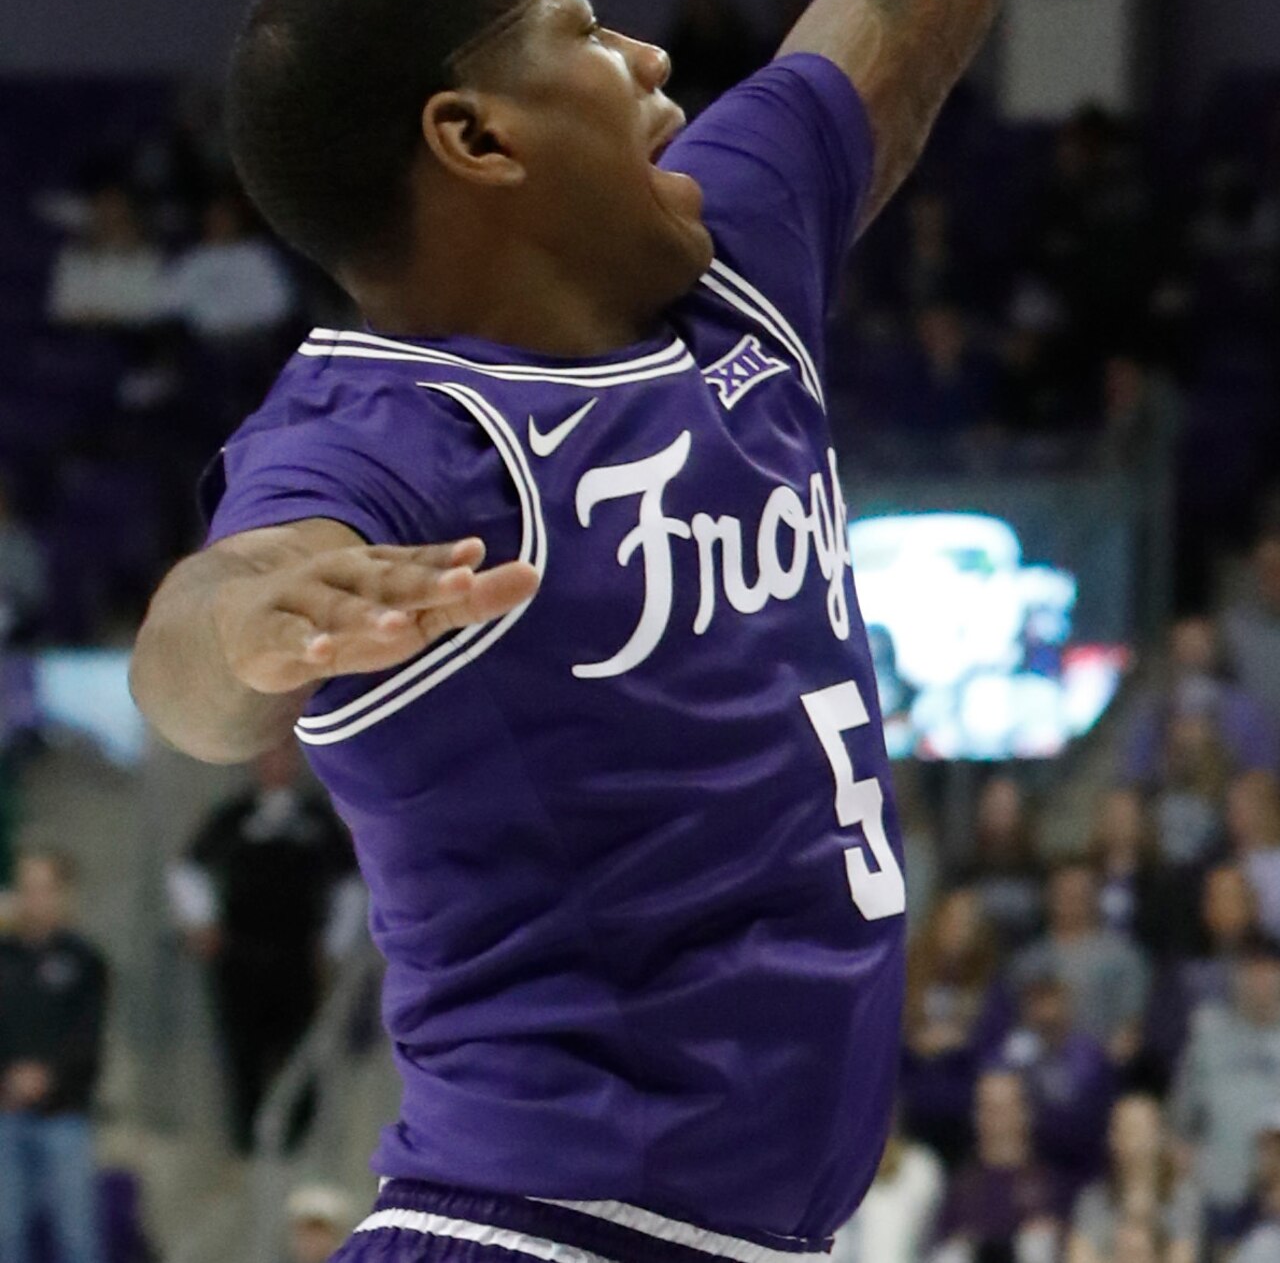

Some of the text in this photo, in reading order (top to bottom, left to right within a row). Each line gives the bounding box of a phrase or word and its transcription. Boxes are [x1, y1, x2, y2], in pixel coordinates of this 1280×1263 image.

[700, 335, 790, 409] XII
[572, 430, 852, 678] Frog
[801, 680, 906, 920] 5
